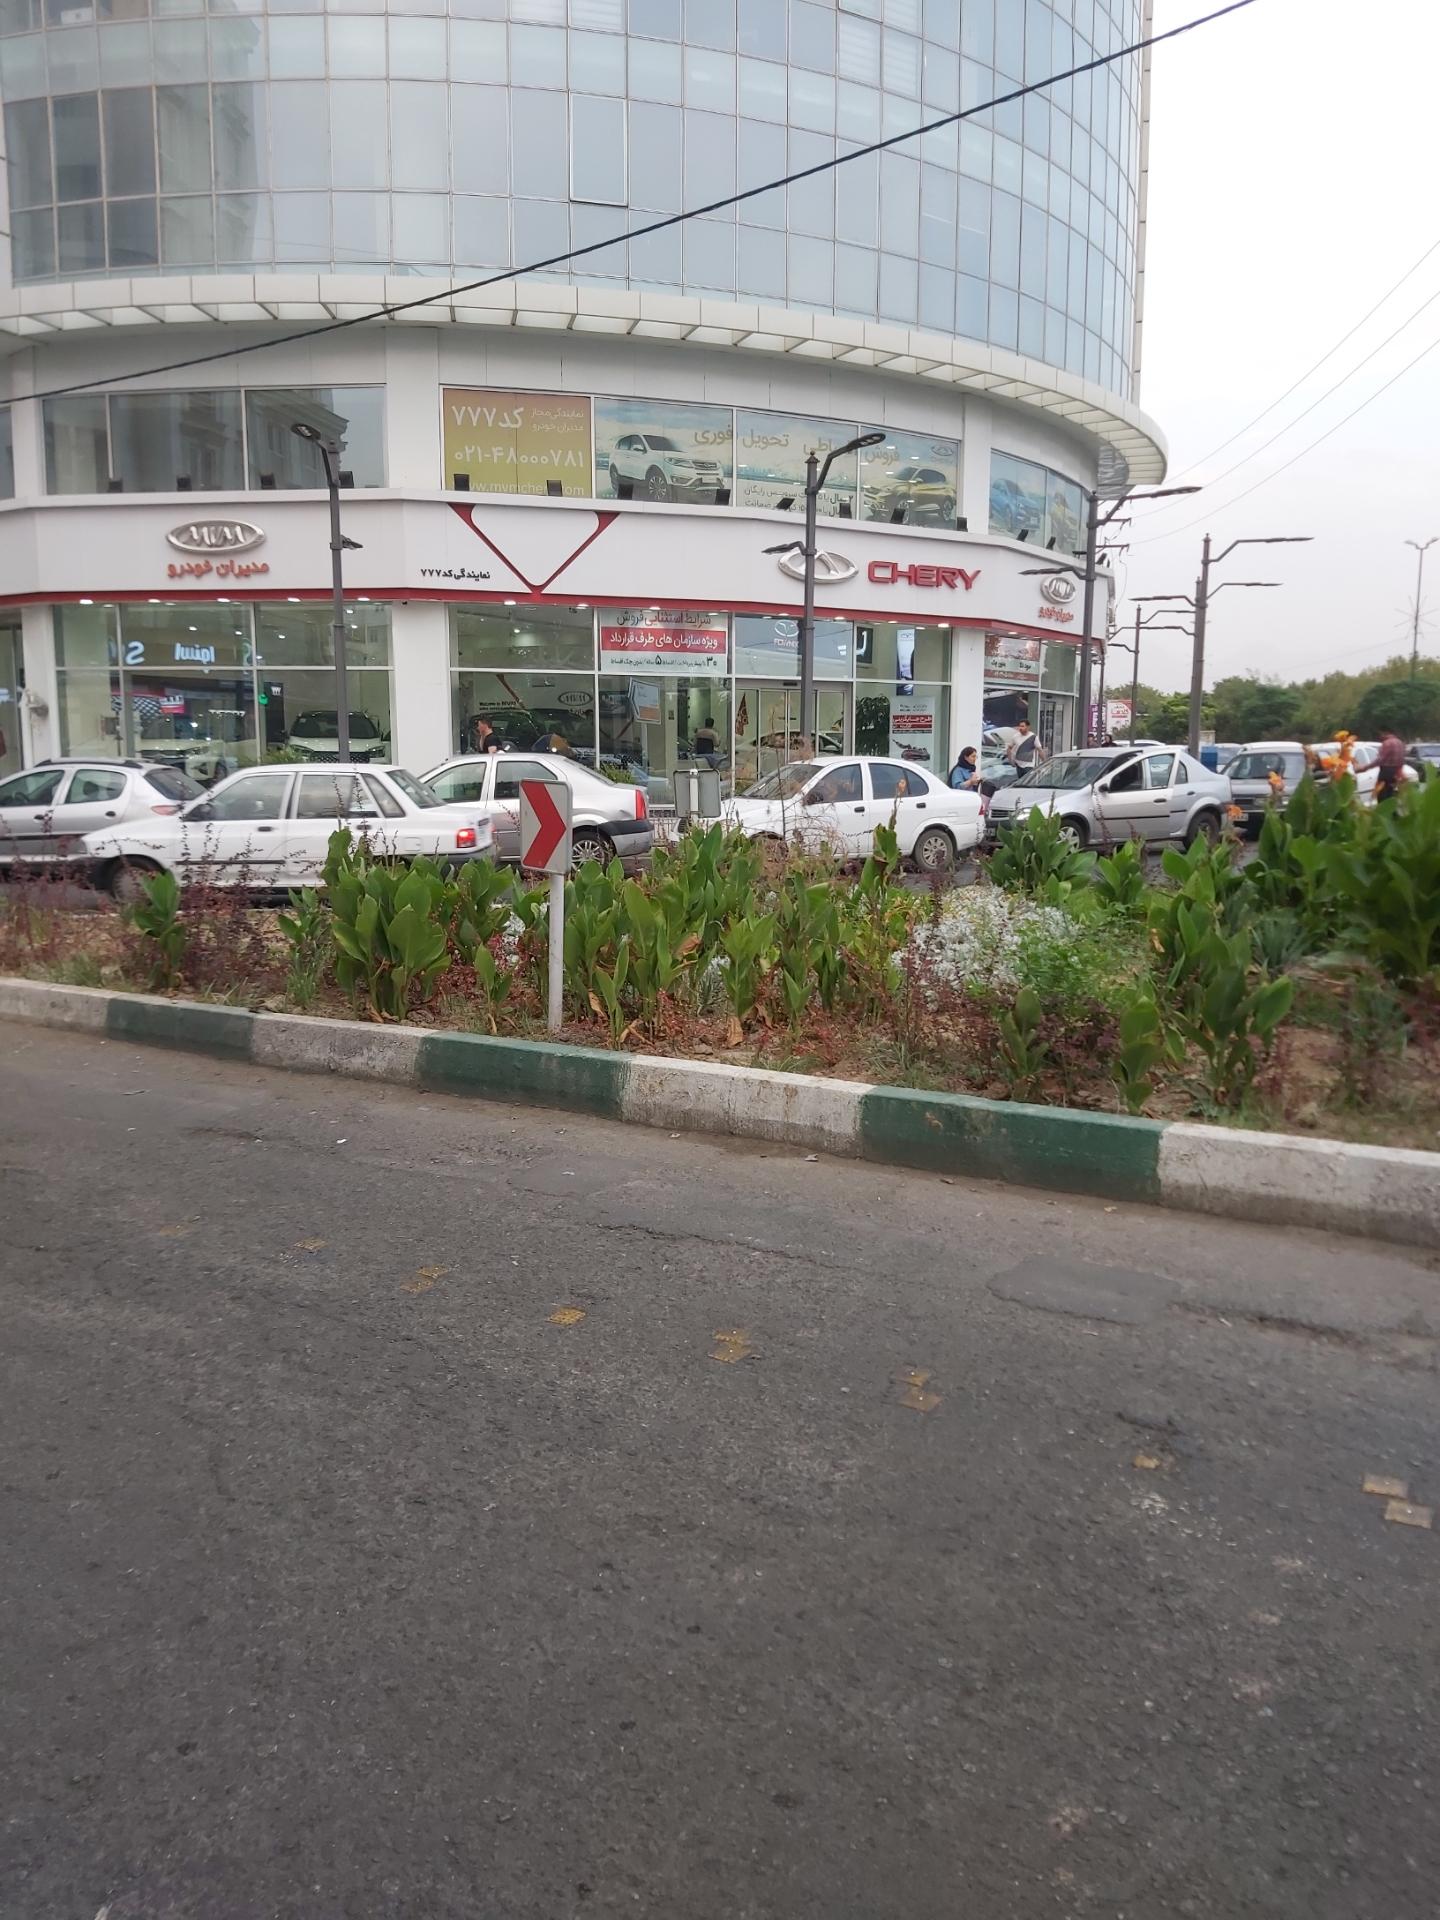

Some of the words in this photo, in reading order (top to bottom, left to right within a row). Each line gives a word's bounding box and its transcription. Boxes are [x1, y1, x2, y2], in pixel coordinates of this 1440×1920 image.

[451, 405, 497, 427] ۷۷۷
[498, 406, 525, 429] کد
[742, 429, 790, 450] تحویل
[167, 559, 213, 578] خودرو
[216, 559, 270, 578] مدیران
[453, 567, 491, 582] نمایندگی
[868, 560, 982, 590] CHERY
[617, 608, 643, 626] فروش
[685, 611, 712, 628] شرایط
[610, 631, 634, 647] قرارداد
[635, 632, 655, 647] طرف
[655, 633, 672, 648] های
[673, 633, 701, 649] سازمان
[701, 637, 718, 649] ویژه
